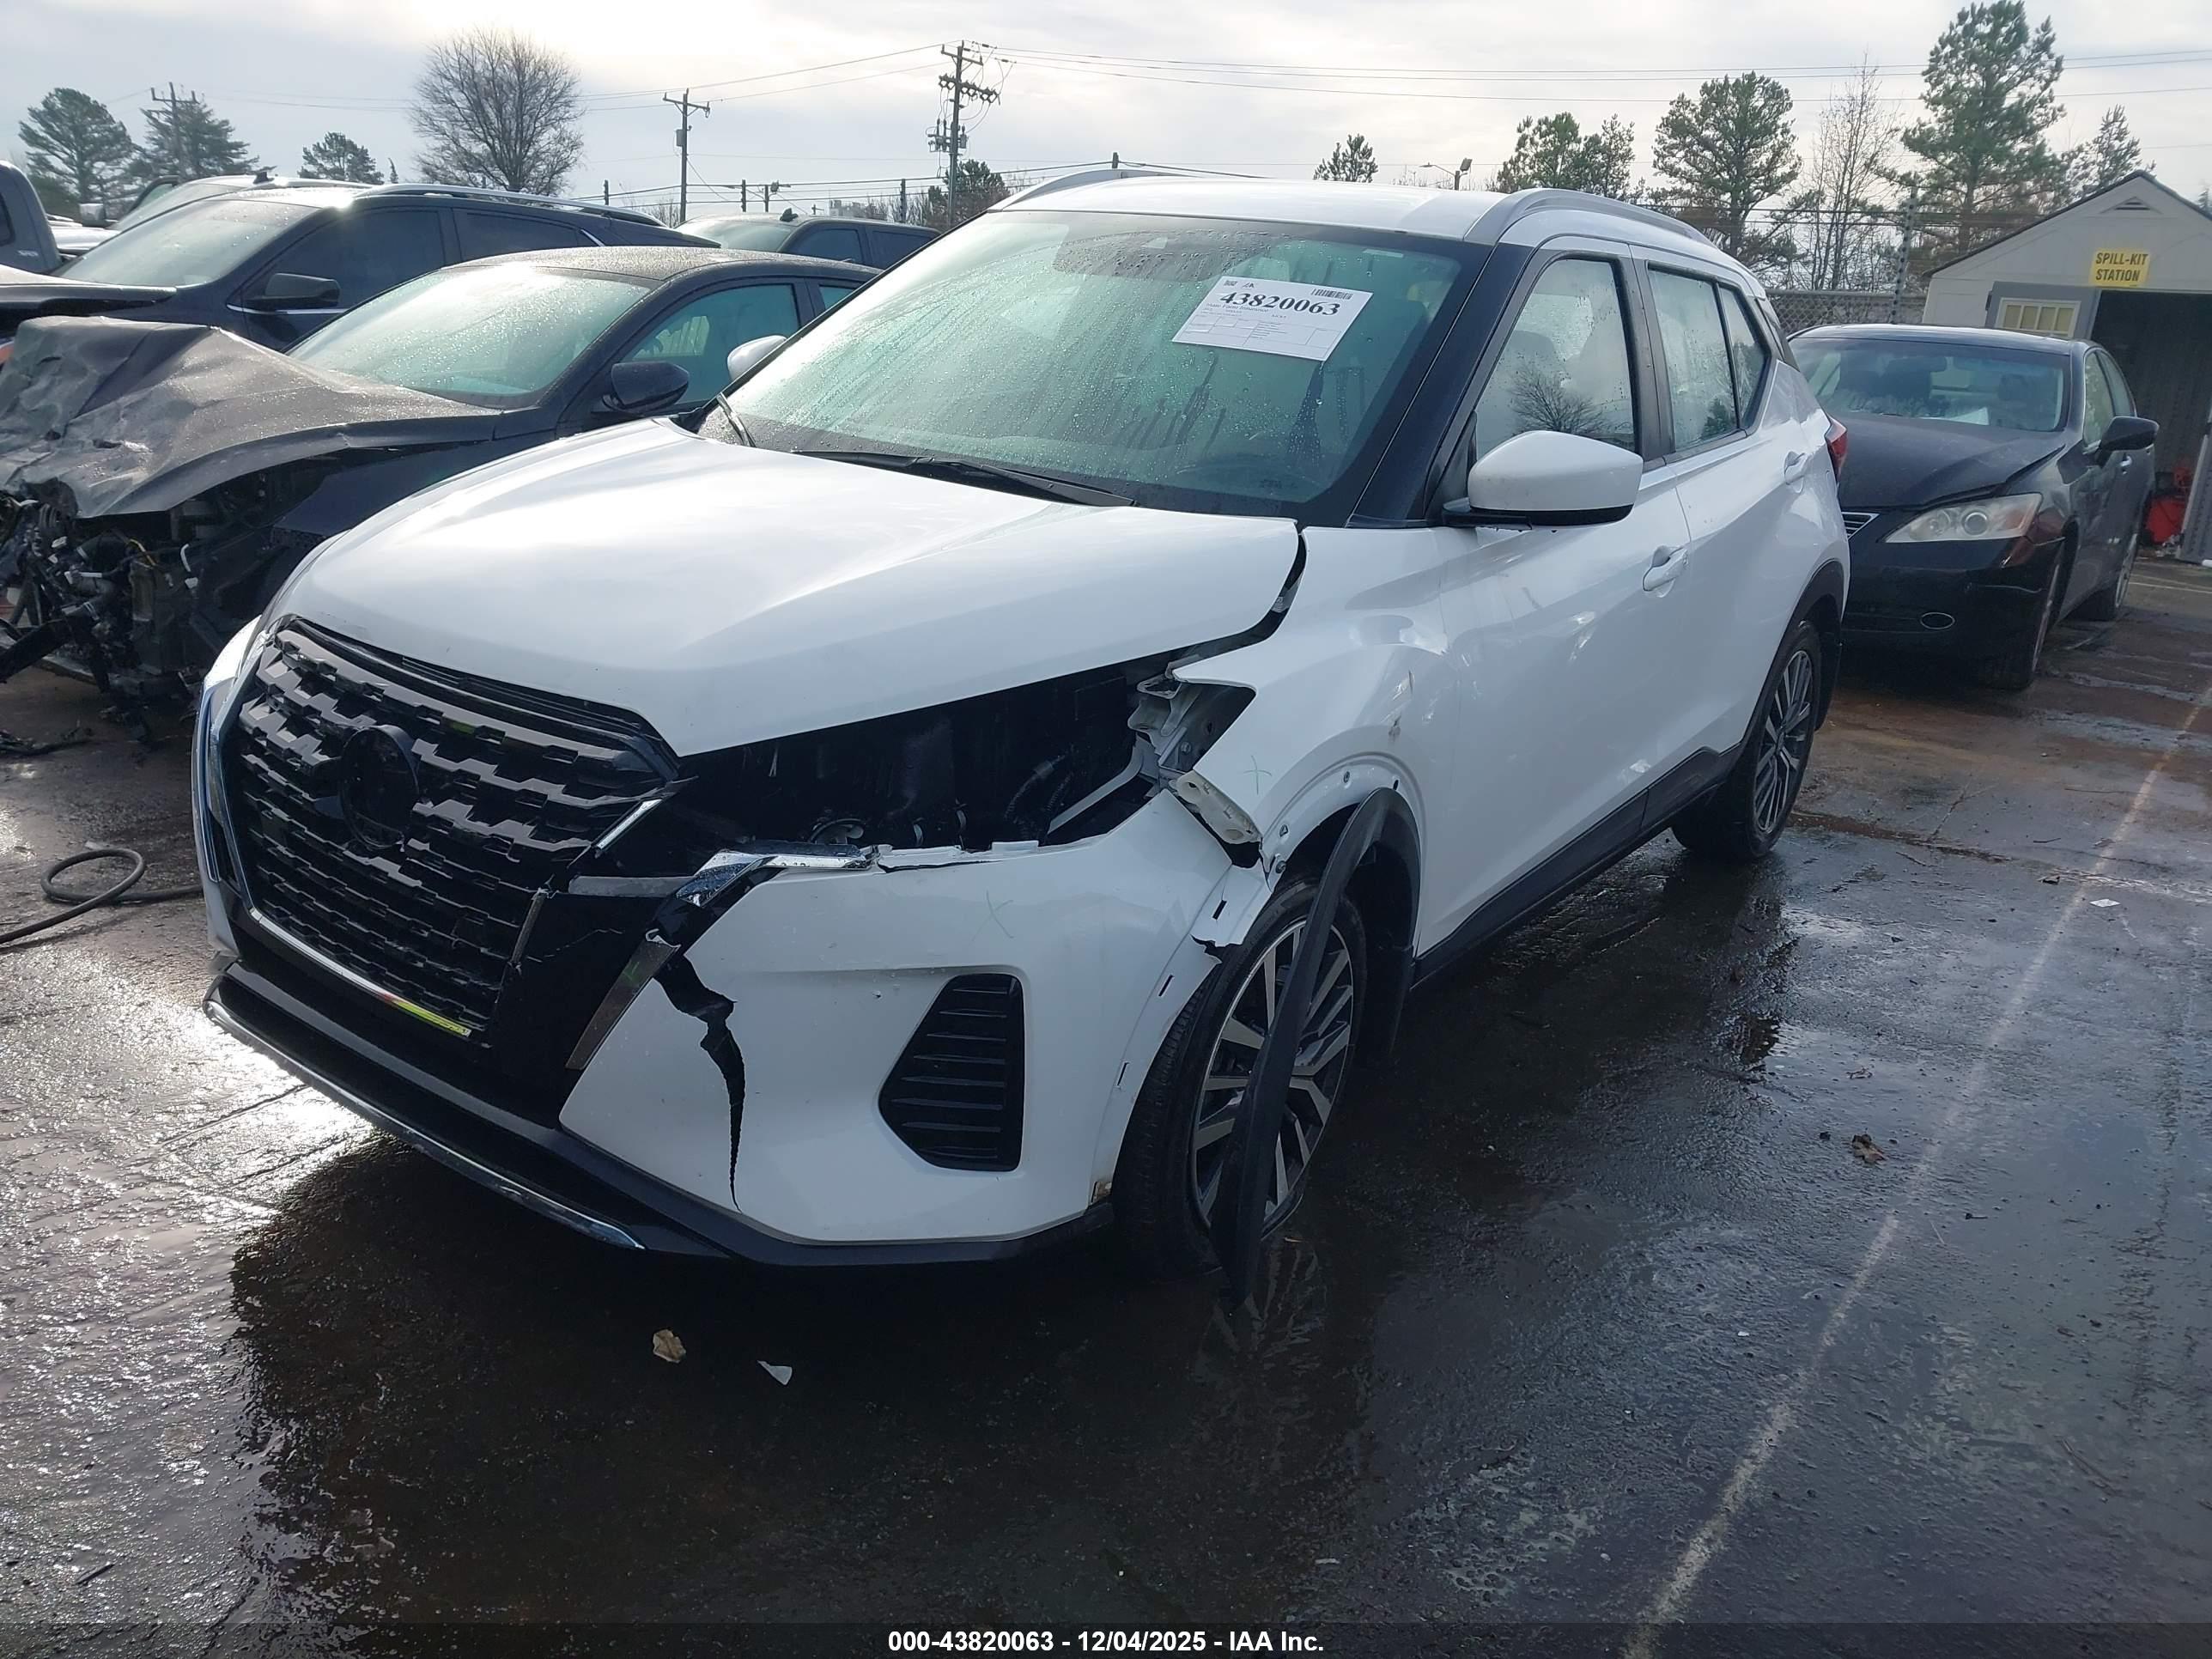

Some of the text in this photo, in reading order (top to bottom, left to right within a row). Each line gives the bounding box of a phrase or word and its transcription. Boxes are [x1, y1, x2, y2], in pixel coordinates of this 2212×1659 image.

[2095, 252, 2148, 265] SPILL-KIT
[2095, 269, 2141, 282] STATION
[1219, 291, 1340, 316] 43820063
